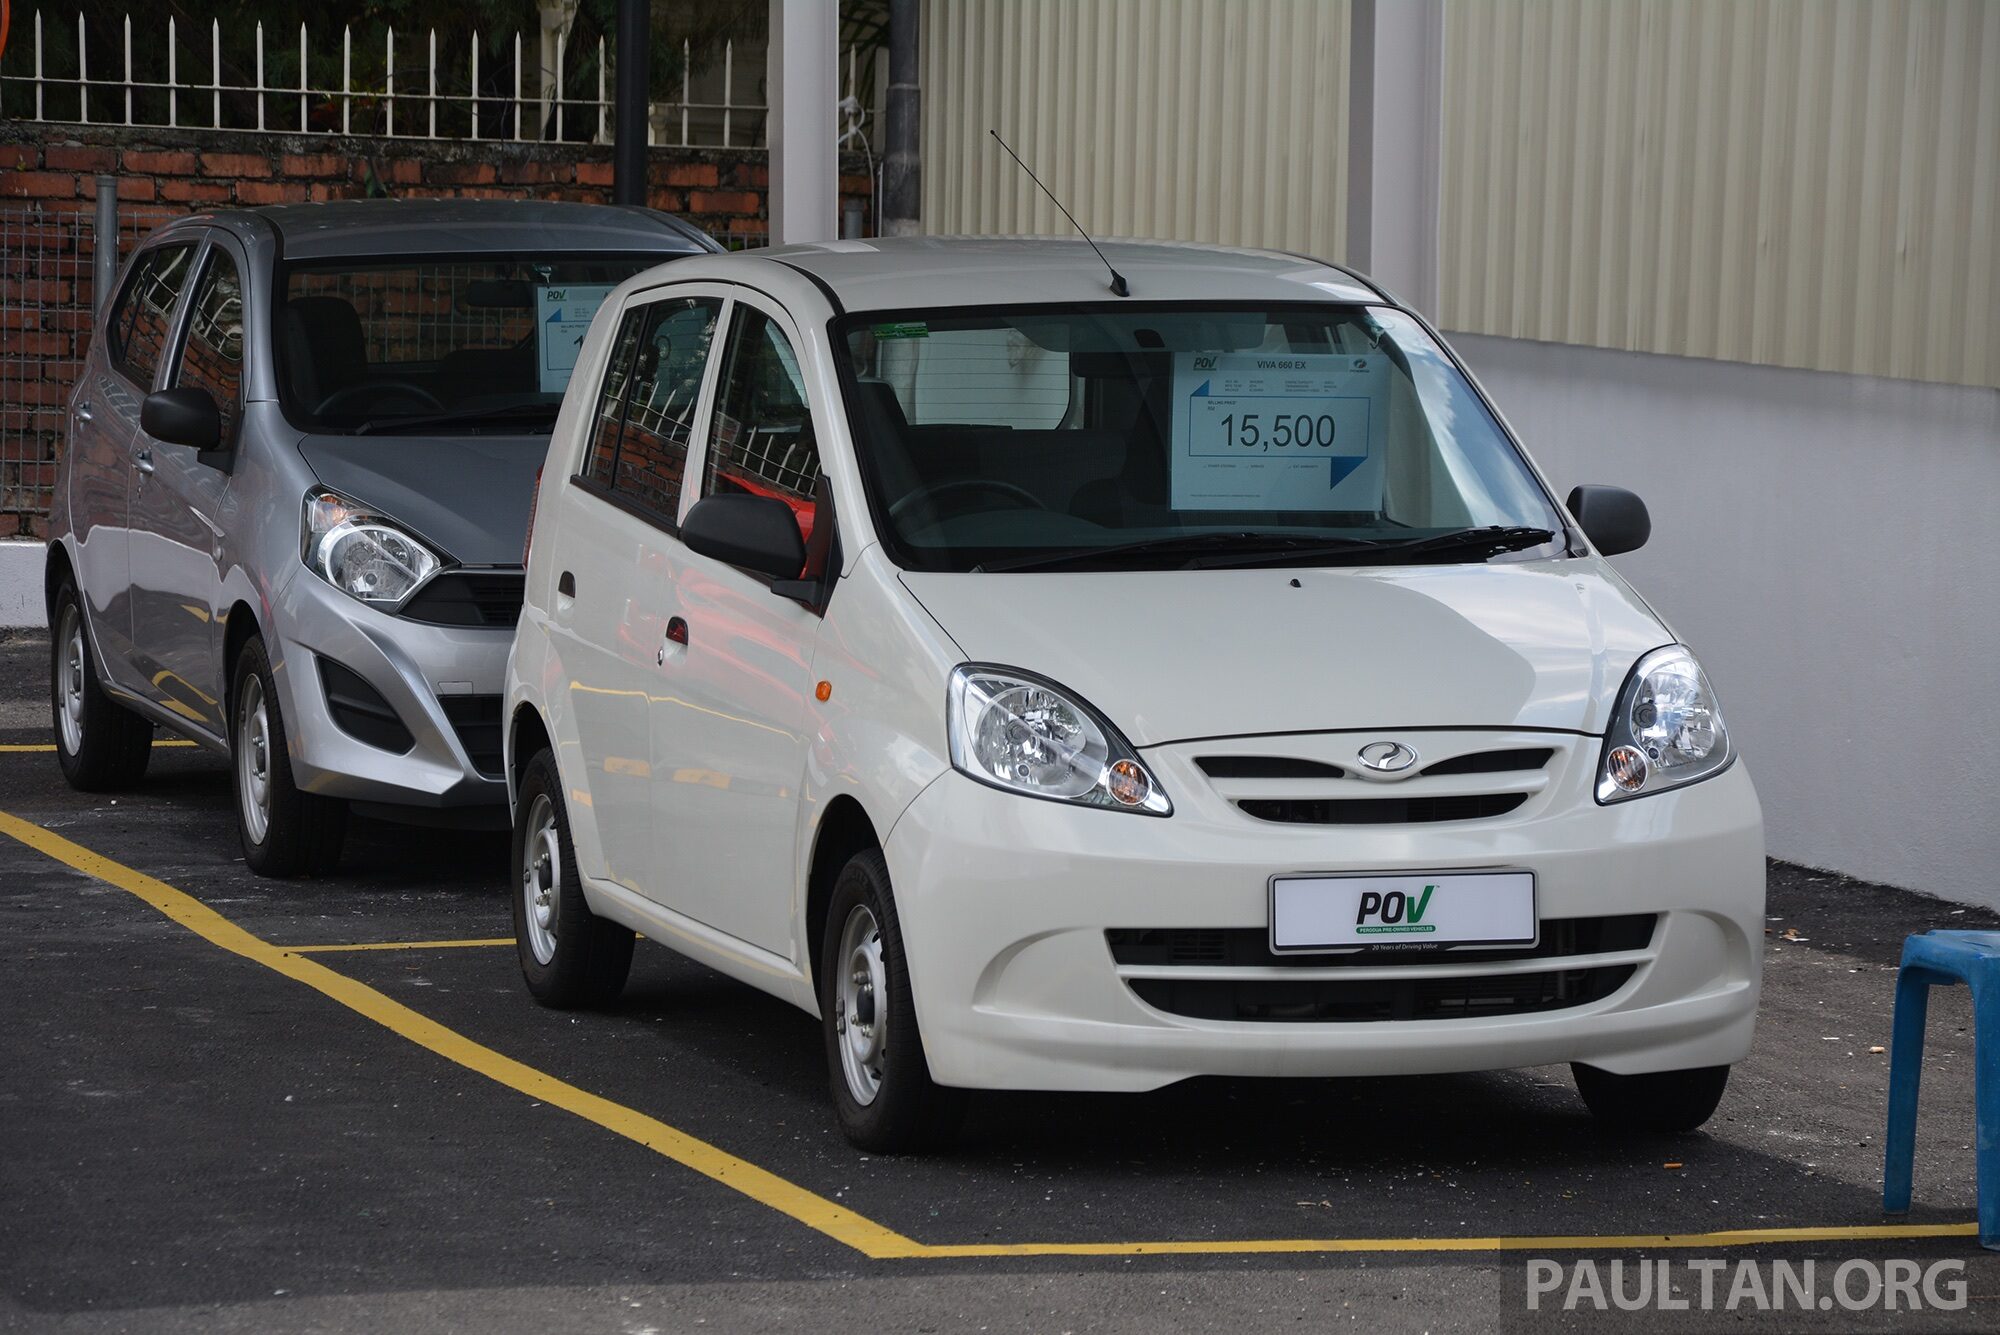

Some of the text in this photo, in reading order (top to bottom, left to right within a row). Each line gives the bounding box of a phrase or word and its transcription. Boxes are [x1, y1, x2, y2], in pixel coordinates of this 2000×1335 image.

[547, 289, 566, 299] POV
[1194, 357, 1217, 369] POV
[1257, 361, 1306, 369] VIVA 660 EX
[1221, 413, 1336, 452] 15,500
[1356, 885, 1435, 925] POV
[1402, 944, 1422, 952] Driving
